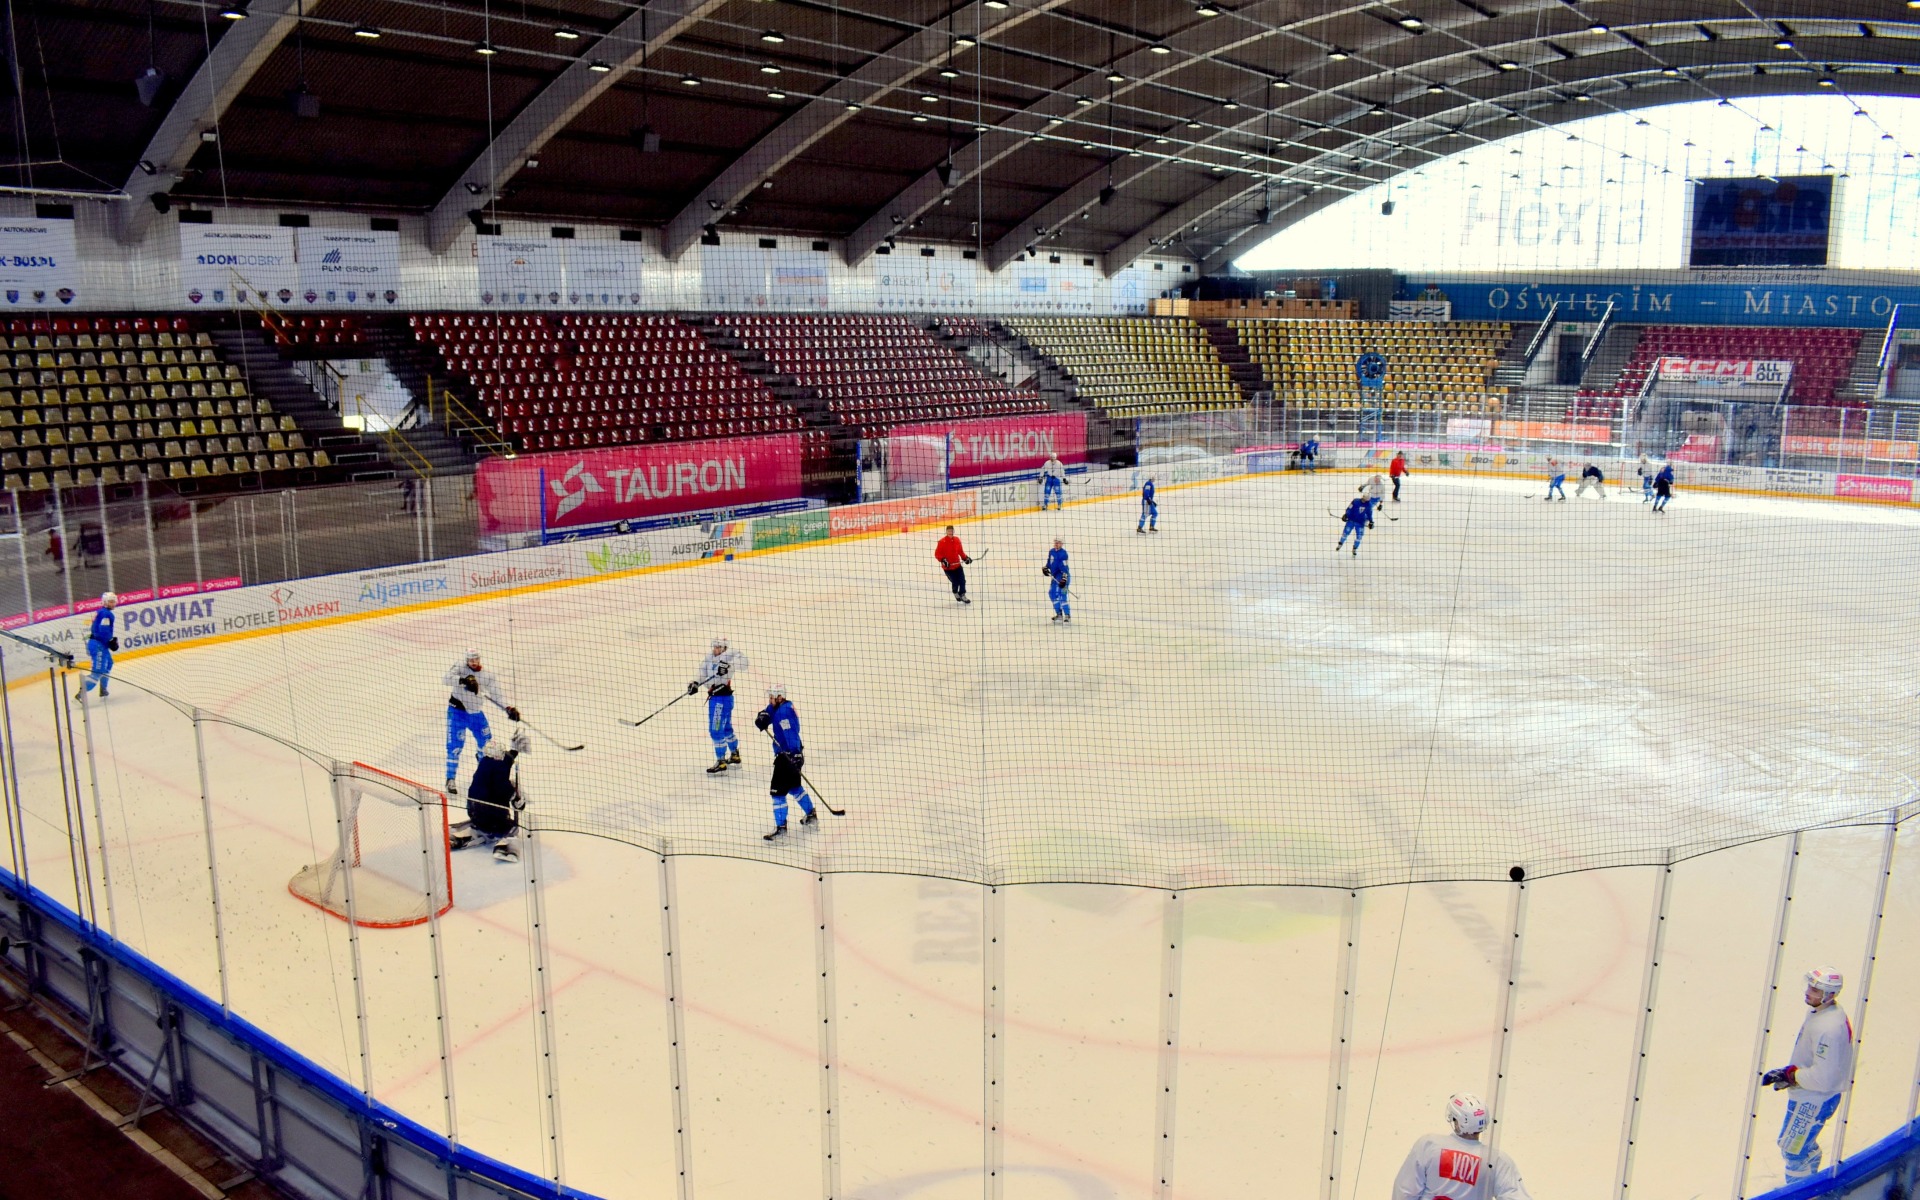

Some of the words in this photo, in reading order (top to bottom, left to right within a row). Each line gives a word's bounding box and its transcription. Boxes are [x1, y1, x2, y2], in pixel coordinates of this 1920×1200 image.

[321, 264, 341, 272] PLM
[345, 265, 378, 273] GROUP
[1488, 287, 1673, 318] OŚWIĘCIM
[1662, 358, 1749, 375] CCM
[1756, 362, 1779, 372] ALL
[968, 427, 1054, 462] TAURON
[607, 456, 746, 504] TAURON
[1859, 484, 1909, 496] TAURON
[803, 521, 828, 535] green
[831, 513, 886, 533] Oświęcim
[671, 536, 743, 556] AUSTROTHERM
[470, 563, 565, 589] StudioMaterace.pl
[358, 576, 447, 604] Aljamex
[123, 597, 215, 632] POWIAT
[223, 610, 276, 631] HOTELE
[278, 600, 341, 622] DIAMENT
[123, 622, 216, 649] OŚWIĘCIMSKI
[1452, 1151, 1480, 1184] VOX
